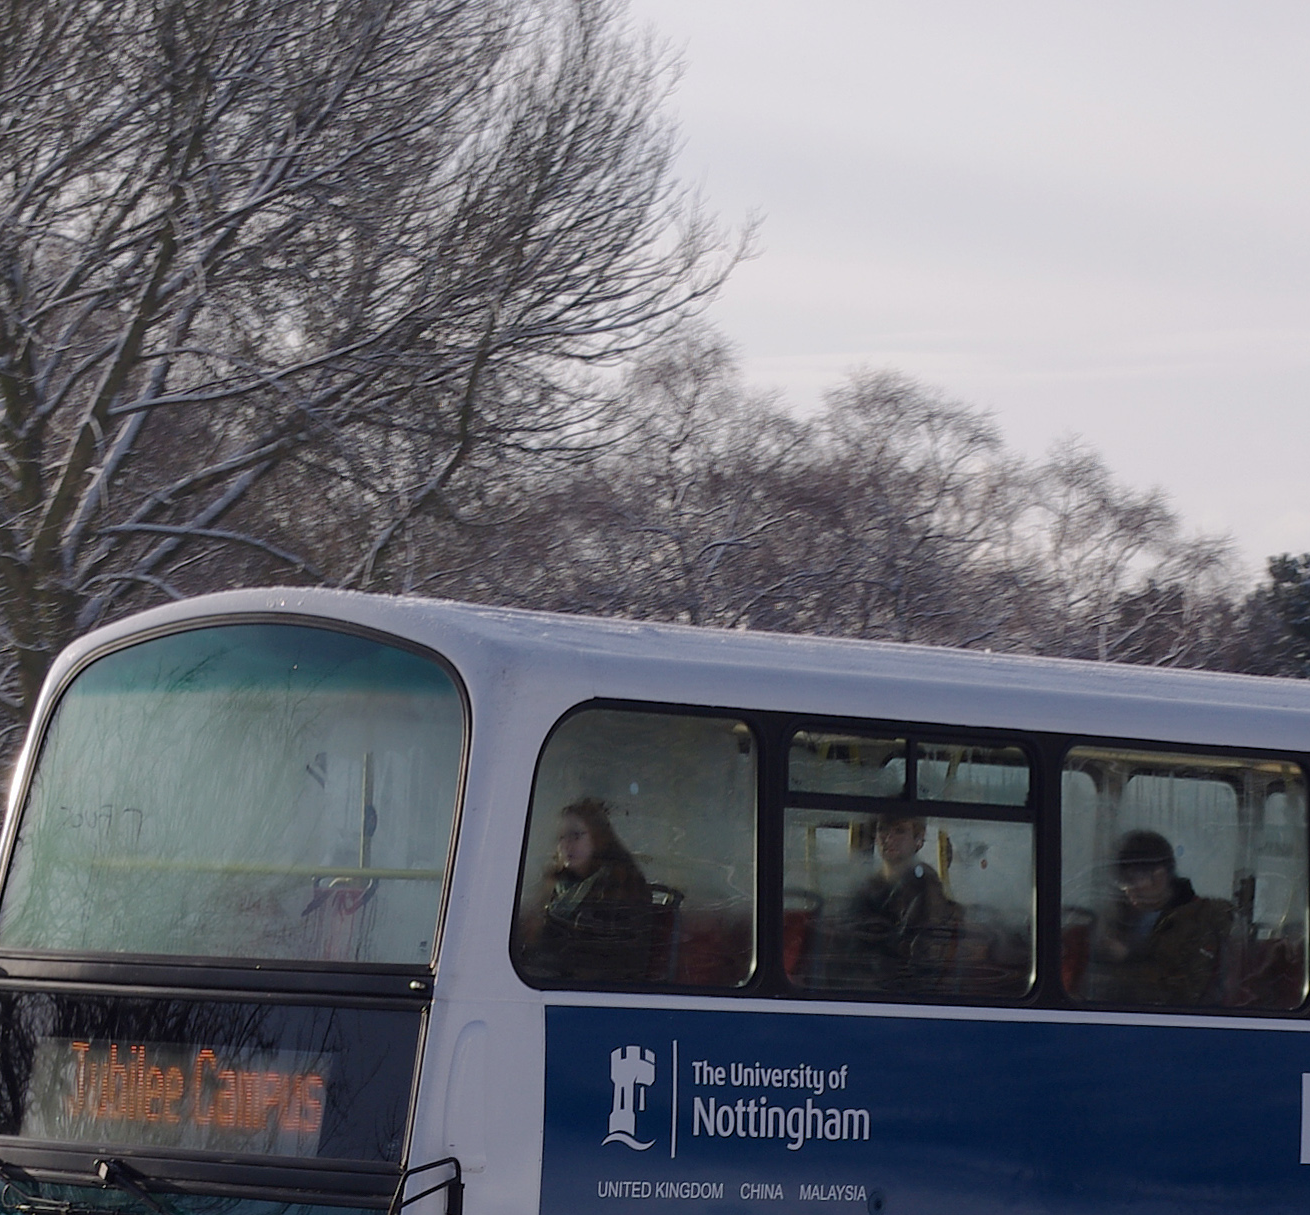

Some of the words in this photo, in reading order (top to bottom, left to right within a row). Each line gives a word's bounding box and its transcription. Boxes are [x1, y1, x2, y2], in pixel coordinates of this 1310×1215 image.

[66, 1041, 184, 1123] Jubilee
[191, 1049, 324, 1132] Campus
[691, 1060, 726, 1087] The
[729, 1061, 824, 1095] University
[828, 1064, 849, 1090] of
[692, 1096, 871, 1151] Nottingham
[597, 1180, 652, 1199] UNITED
[654, 1181, 725, 1199] KINGDOM
[739, 1183, 784, 1200] CHINA
[799, 1184, 867, 1201] MALAYSIA
